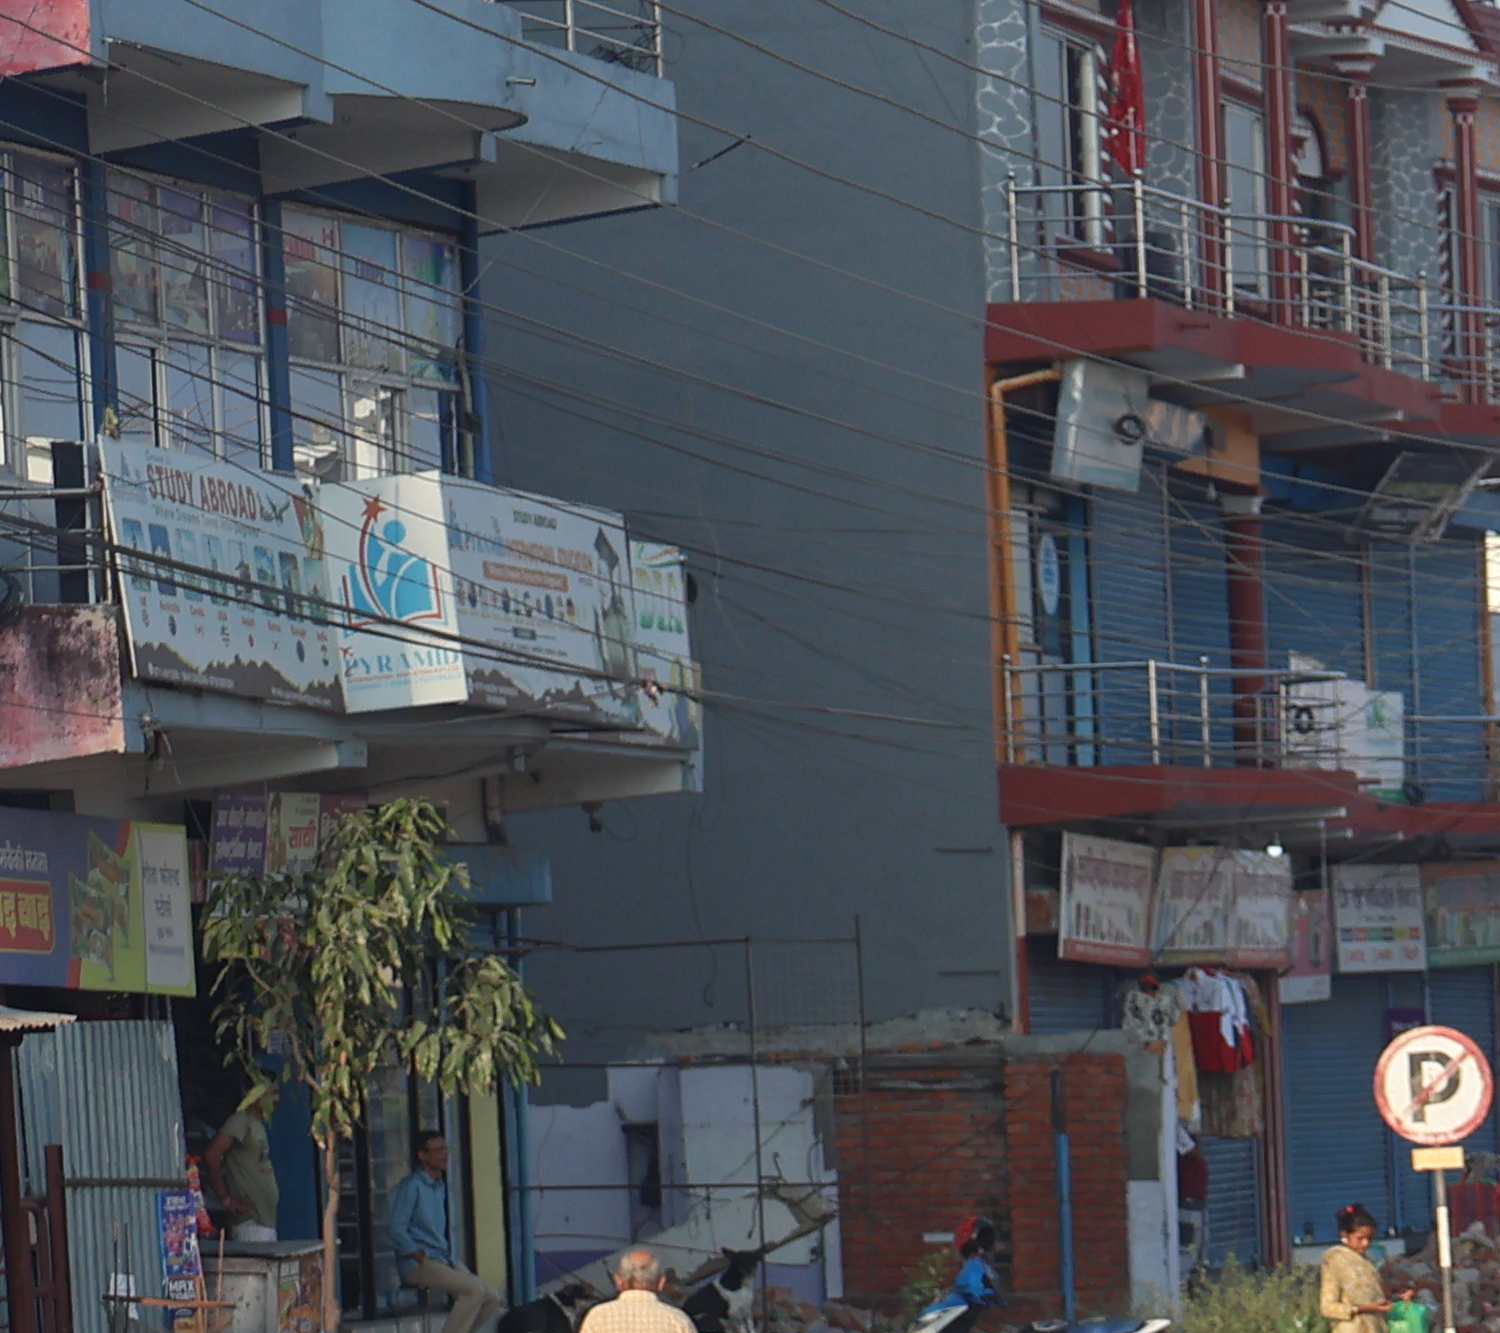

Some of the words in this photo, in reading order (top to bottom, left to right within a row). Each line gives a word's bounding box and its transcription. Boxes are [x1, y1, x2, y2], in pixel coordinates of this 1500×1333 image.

[146, 464, 193, 505] STUDY
[200, 474, 257, 521] ABROAD
[344, 649, 461, 677] PYRAMID
[1409, 1051, 1462, 1122] P
